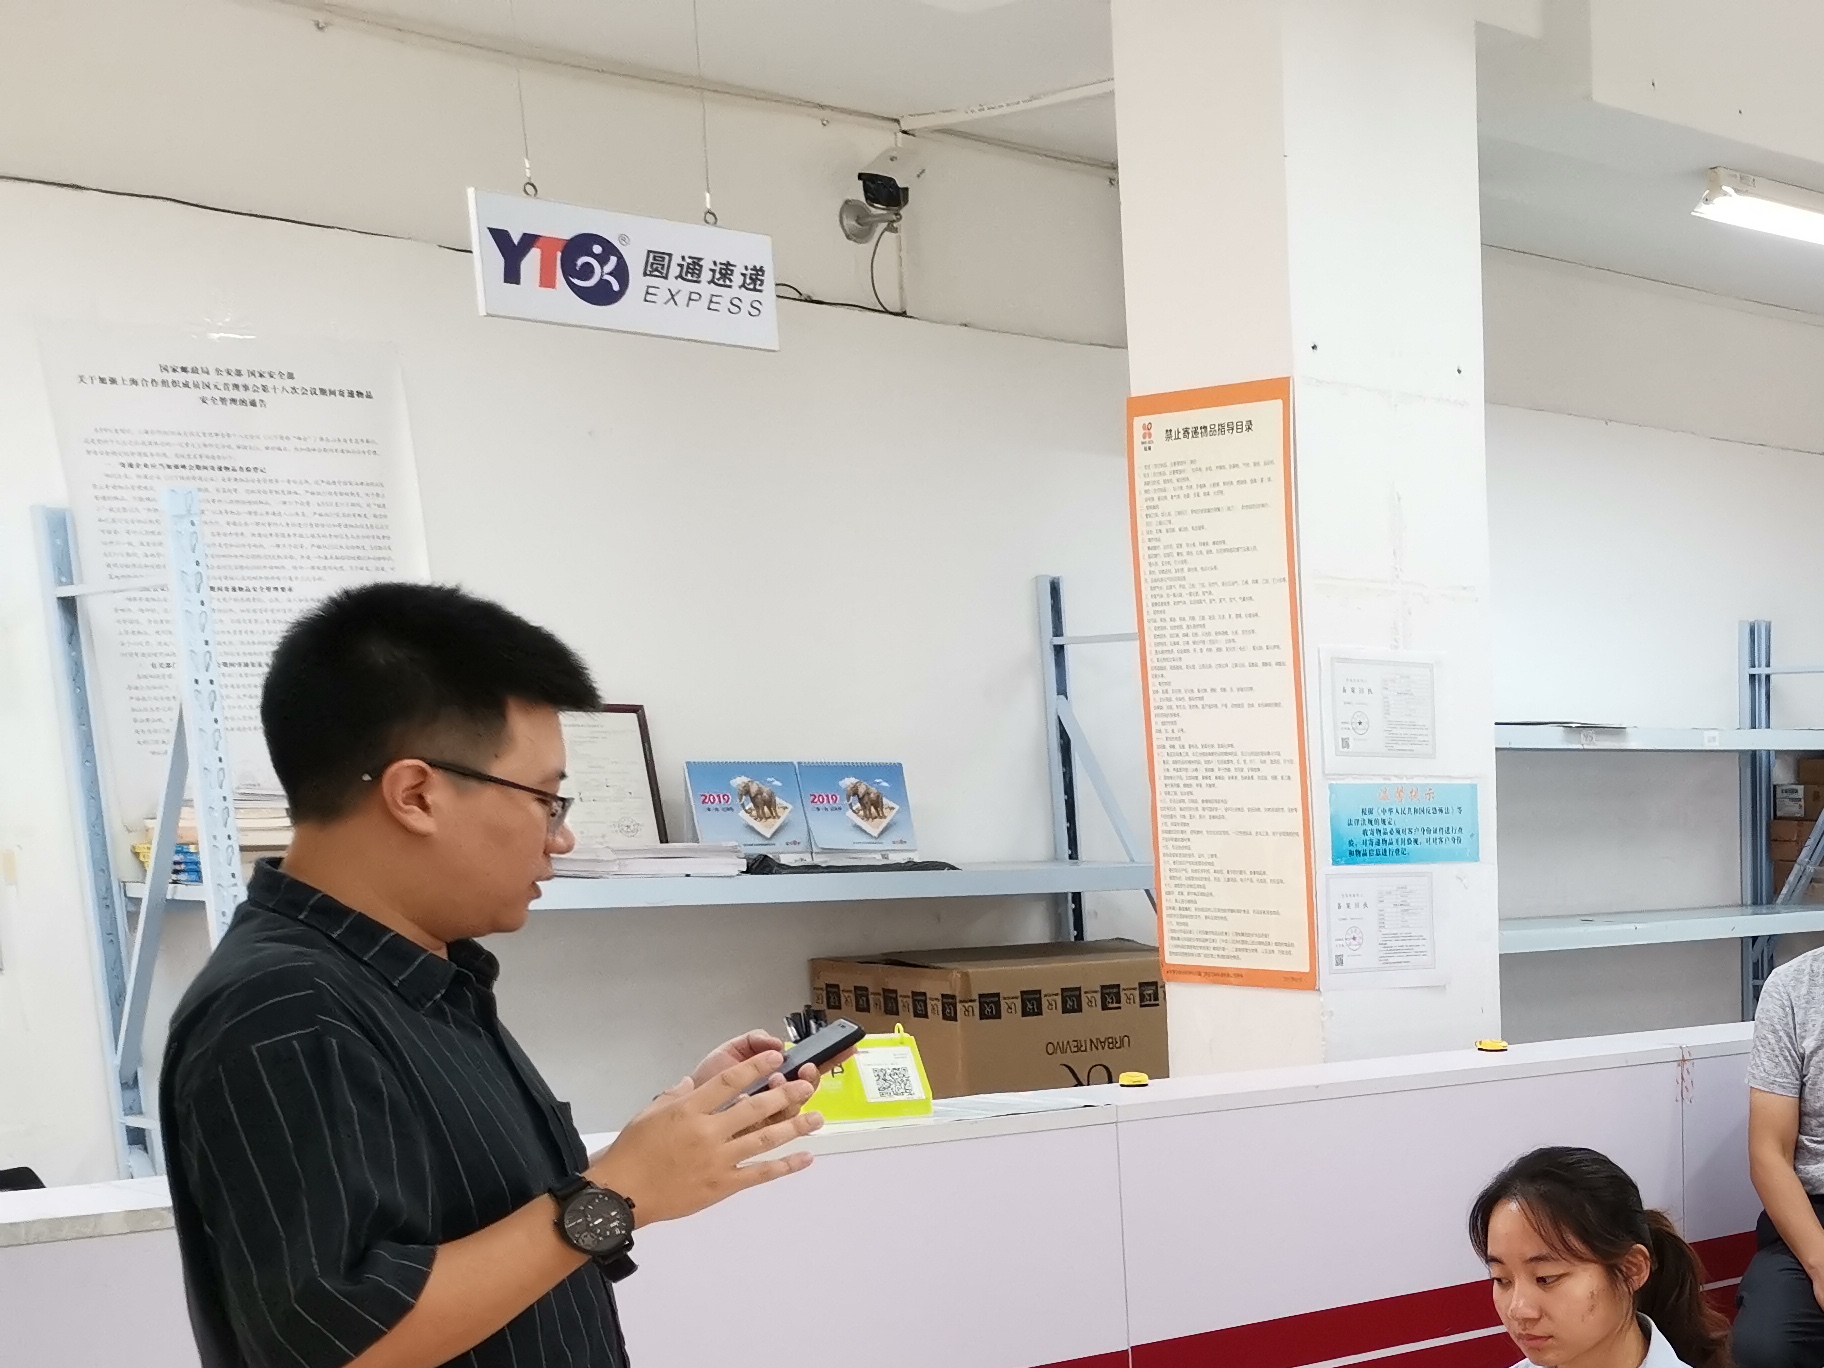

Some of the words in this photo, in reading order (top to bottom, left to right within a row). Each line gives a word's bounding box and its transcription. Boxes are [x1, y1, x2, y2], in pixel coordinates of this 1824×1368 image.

[642, 249, 767, 294] 圆通速递
[642, 284, 764, 318] EXPESS
[1164, 420, 1254, 442] 禁止寄递物品指导目录
[701, 793, 731, 805] 2019
[810, 793, 839, 805] 2019
[1045, 1039, 1089, 1056] REVIVO
[1089, 1034, 1131, 1052] URBAN
